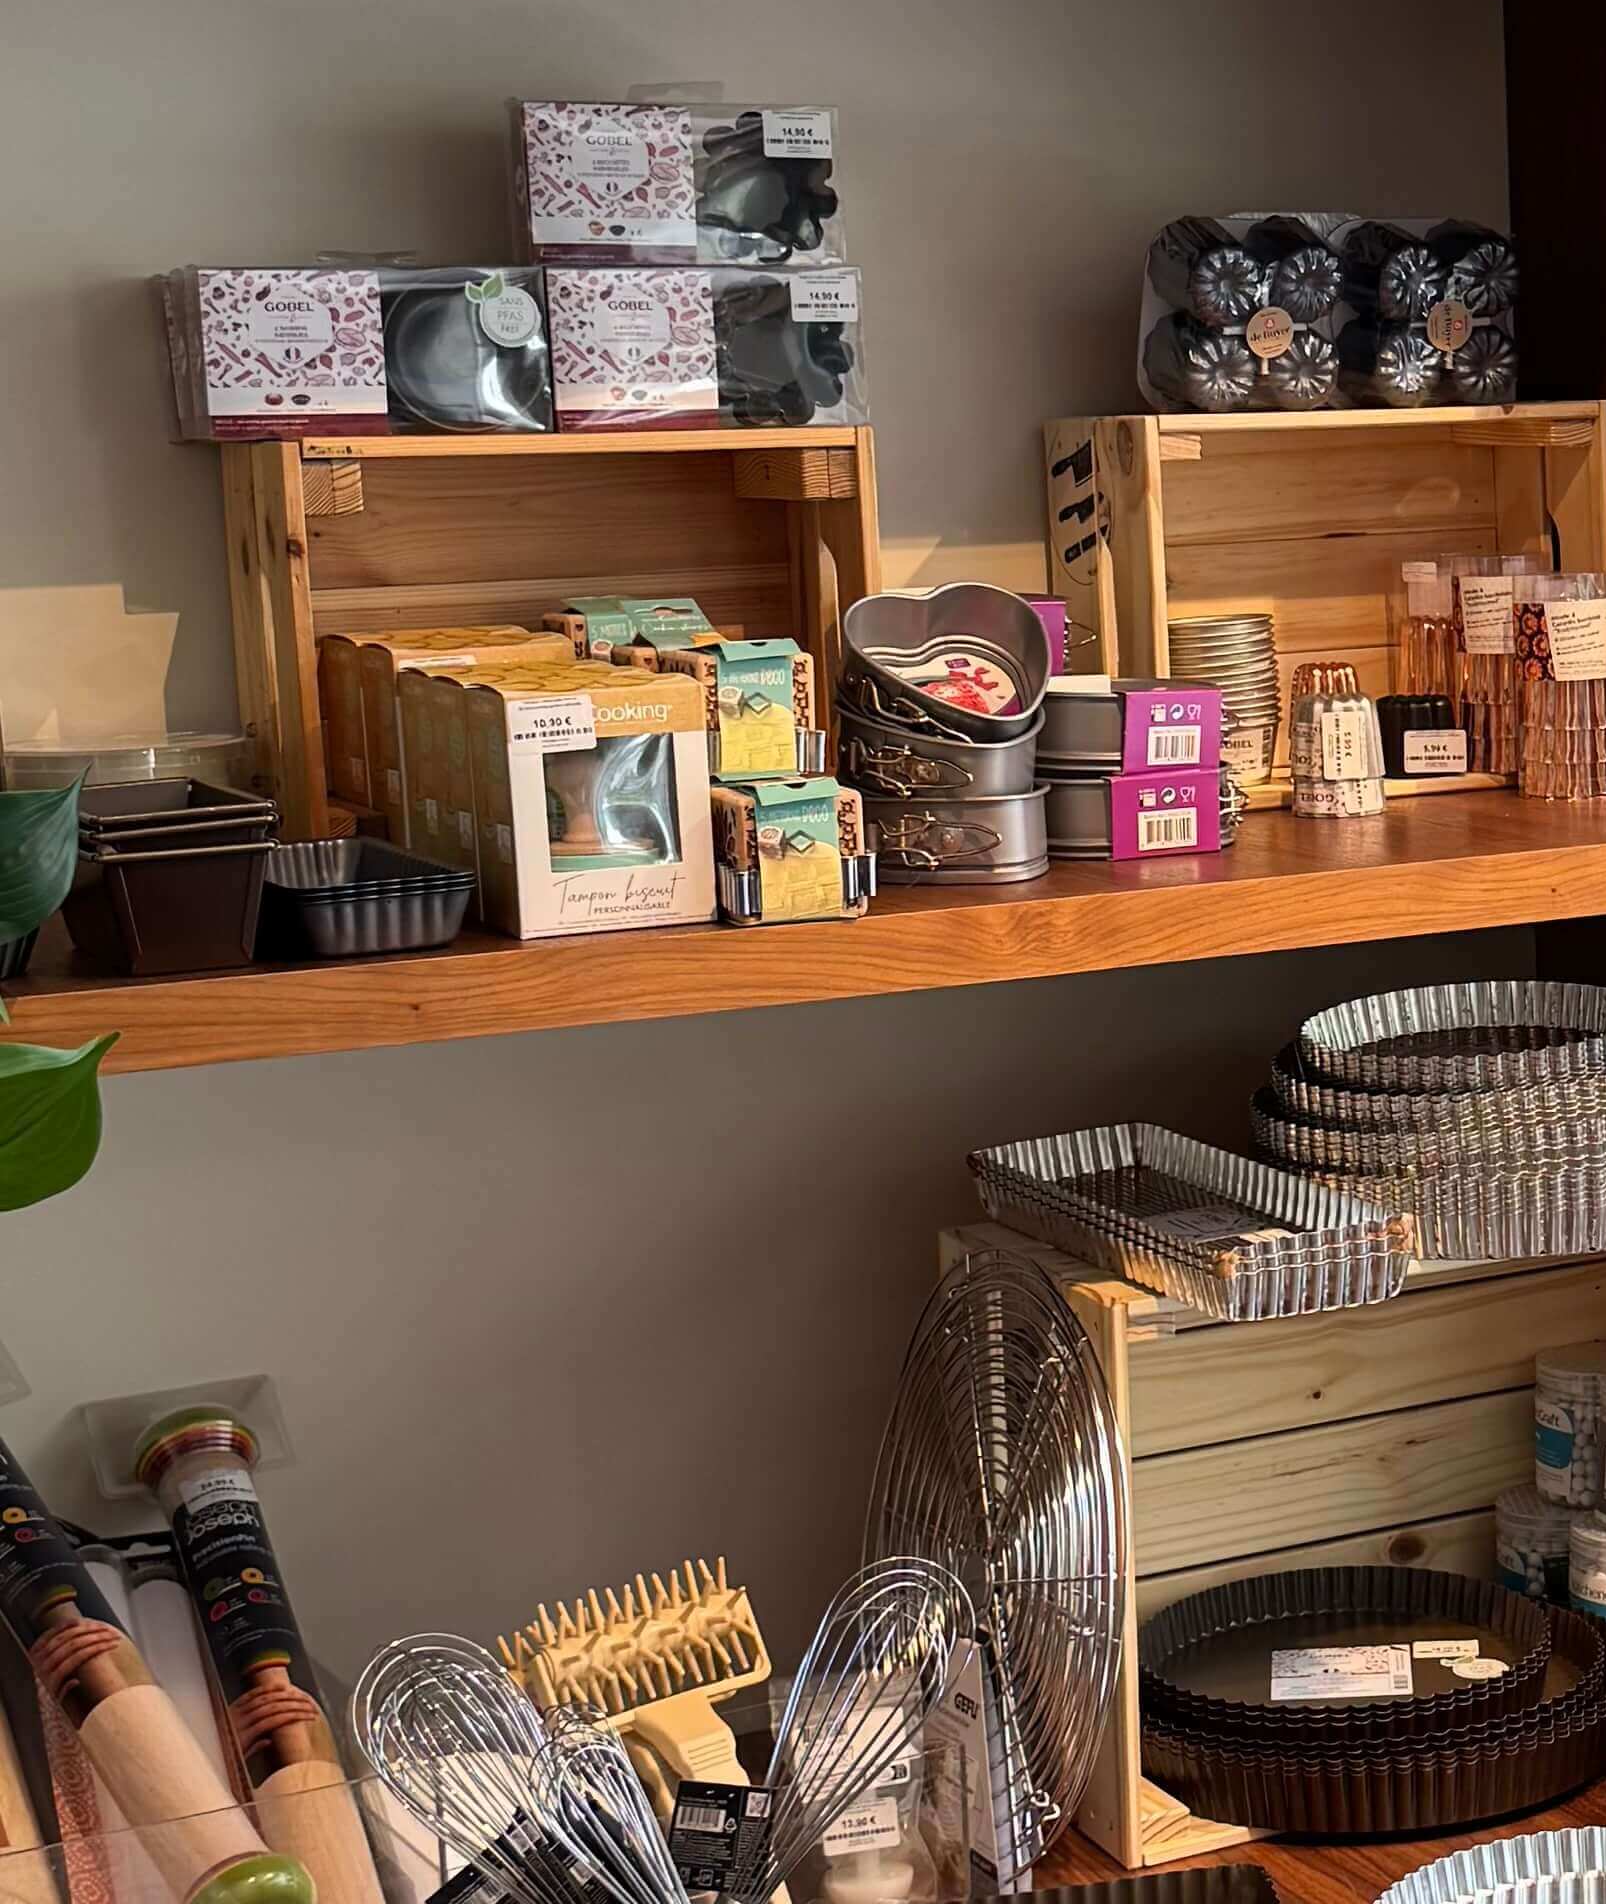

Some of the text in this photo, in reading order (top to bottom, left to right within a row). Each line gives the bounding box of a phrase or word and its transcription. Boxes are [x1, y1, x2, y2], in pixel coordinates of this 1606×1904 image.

[585, 135, 633, 146] GOBEL
[264, 301, 315, 313] GOBEL
[607, 300, 653, 311] GOBEL
[496, 310, 524, 321] PFAS
[592, 703, 668, 722] Cooking
[1223, 738, 1253, 750] OBEL
[553, 871, 687, 915] Tampon biscuit
[953, 1691, 979, 1720] GEFU
